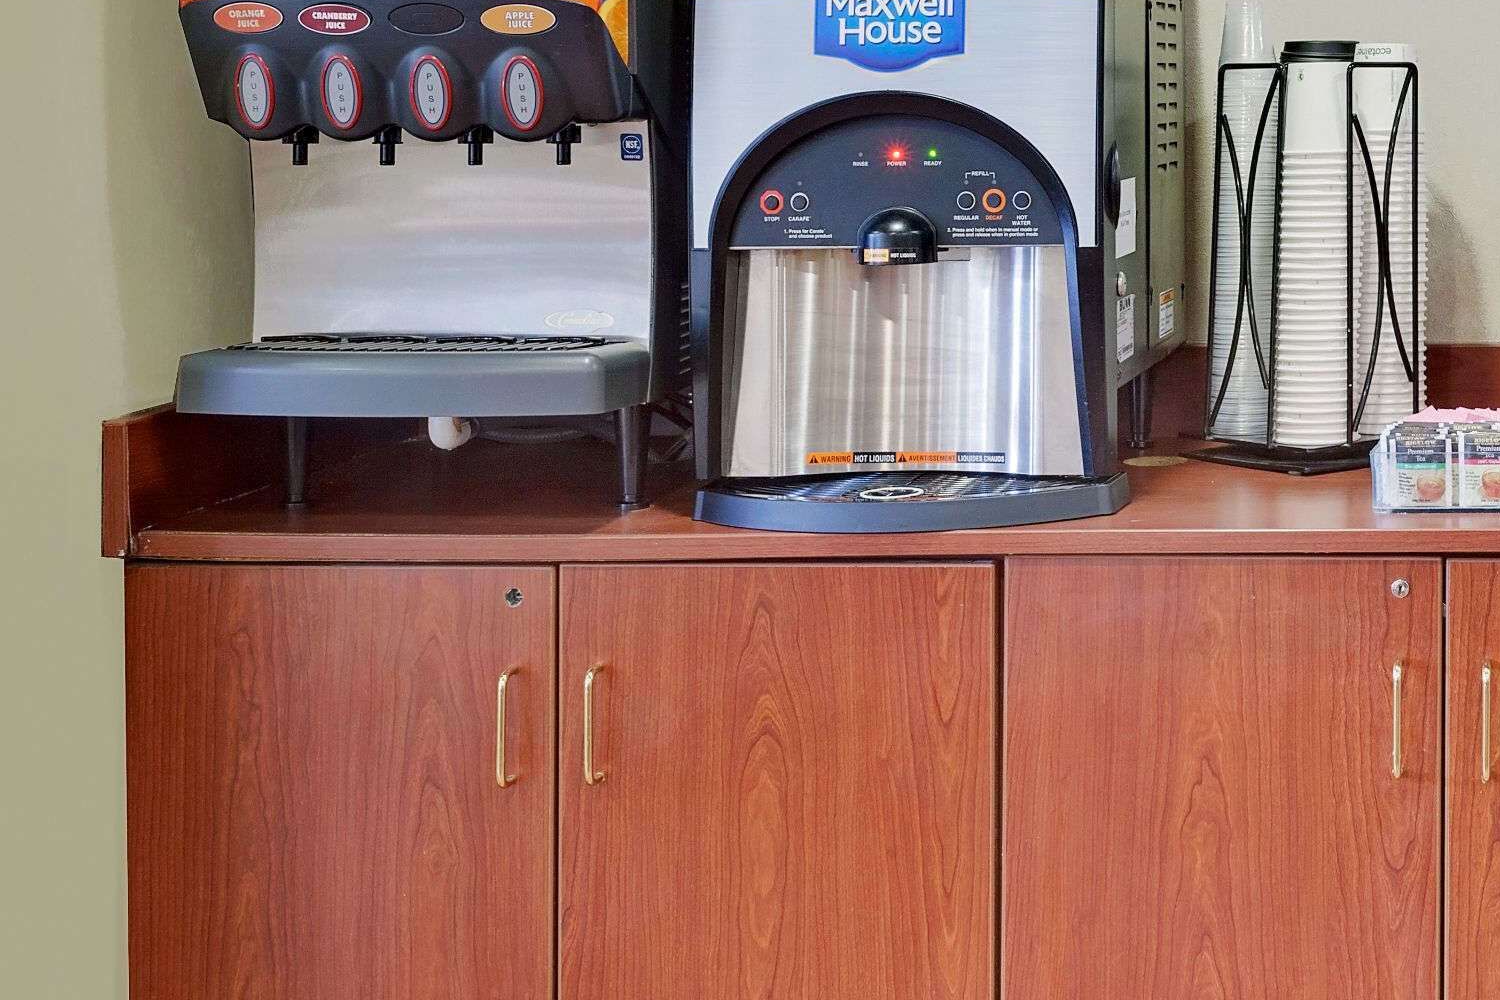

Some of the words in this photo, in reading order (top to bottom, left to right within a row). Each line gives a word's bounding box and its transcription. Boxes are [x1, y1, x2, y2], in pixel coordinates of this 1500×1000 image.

[229, 9, 265, 19] ORANGE
[312, 11, 357, 21] CRANBERRY
[505, 11, 535, 20] APPLE
[238, 19, 260, 28] JUICE
[325, 21, 346, 30] JUICE
[508, 19, 533, 28] JUICE
[838, 17, 942, 45] House
[625, 140, 638, 149] NSF
[820, 455, 851, 463] WARNING
[854, 453, 868, 463] HOT
[869, 453, 895, 463] LIQUIDS
[908, 454, 956, 463] AVERTISSEMENT
[957, 454, 983, 463] LIQUIDES
[984, 454, 1005, 463] CHAUDS
